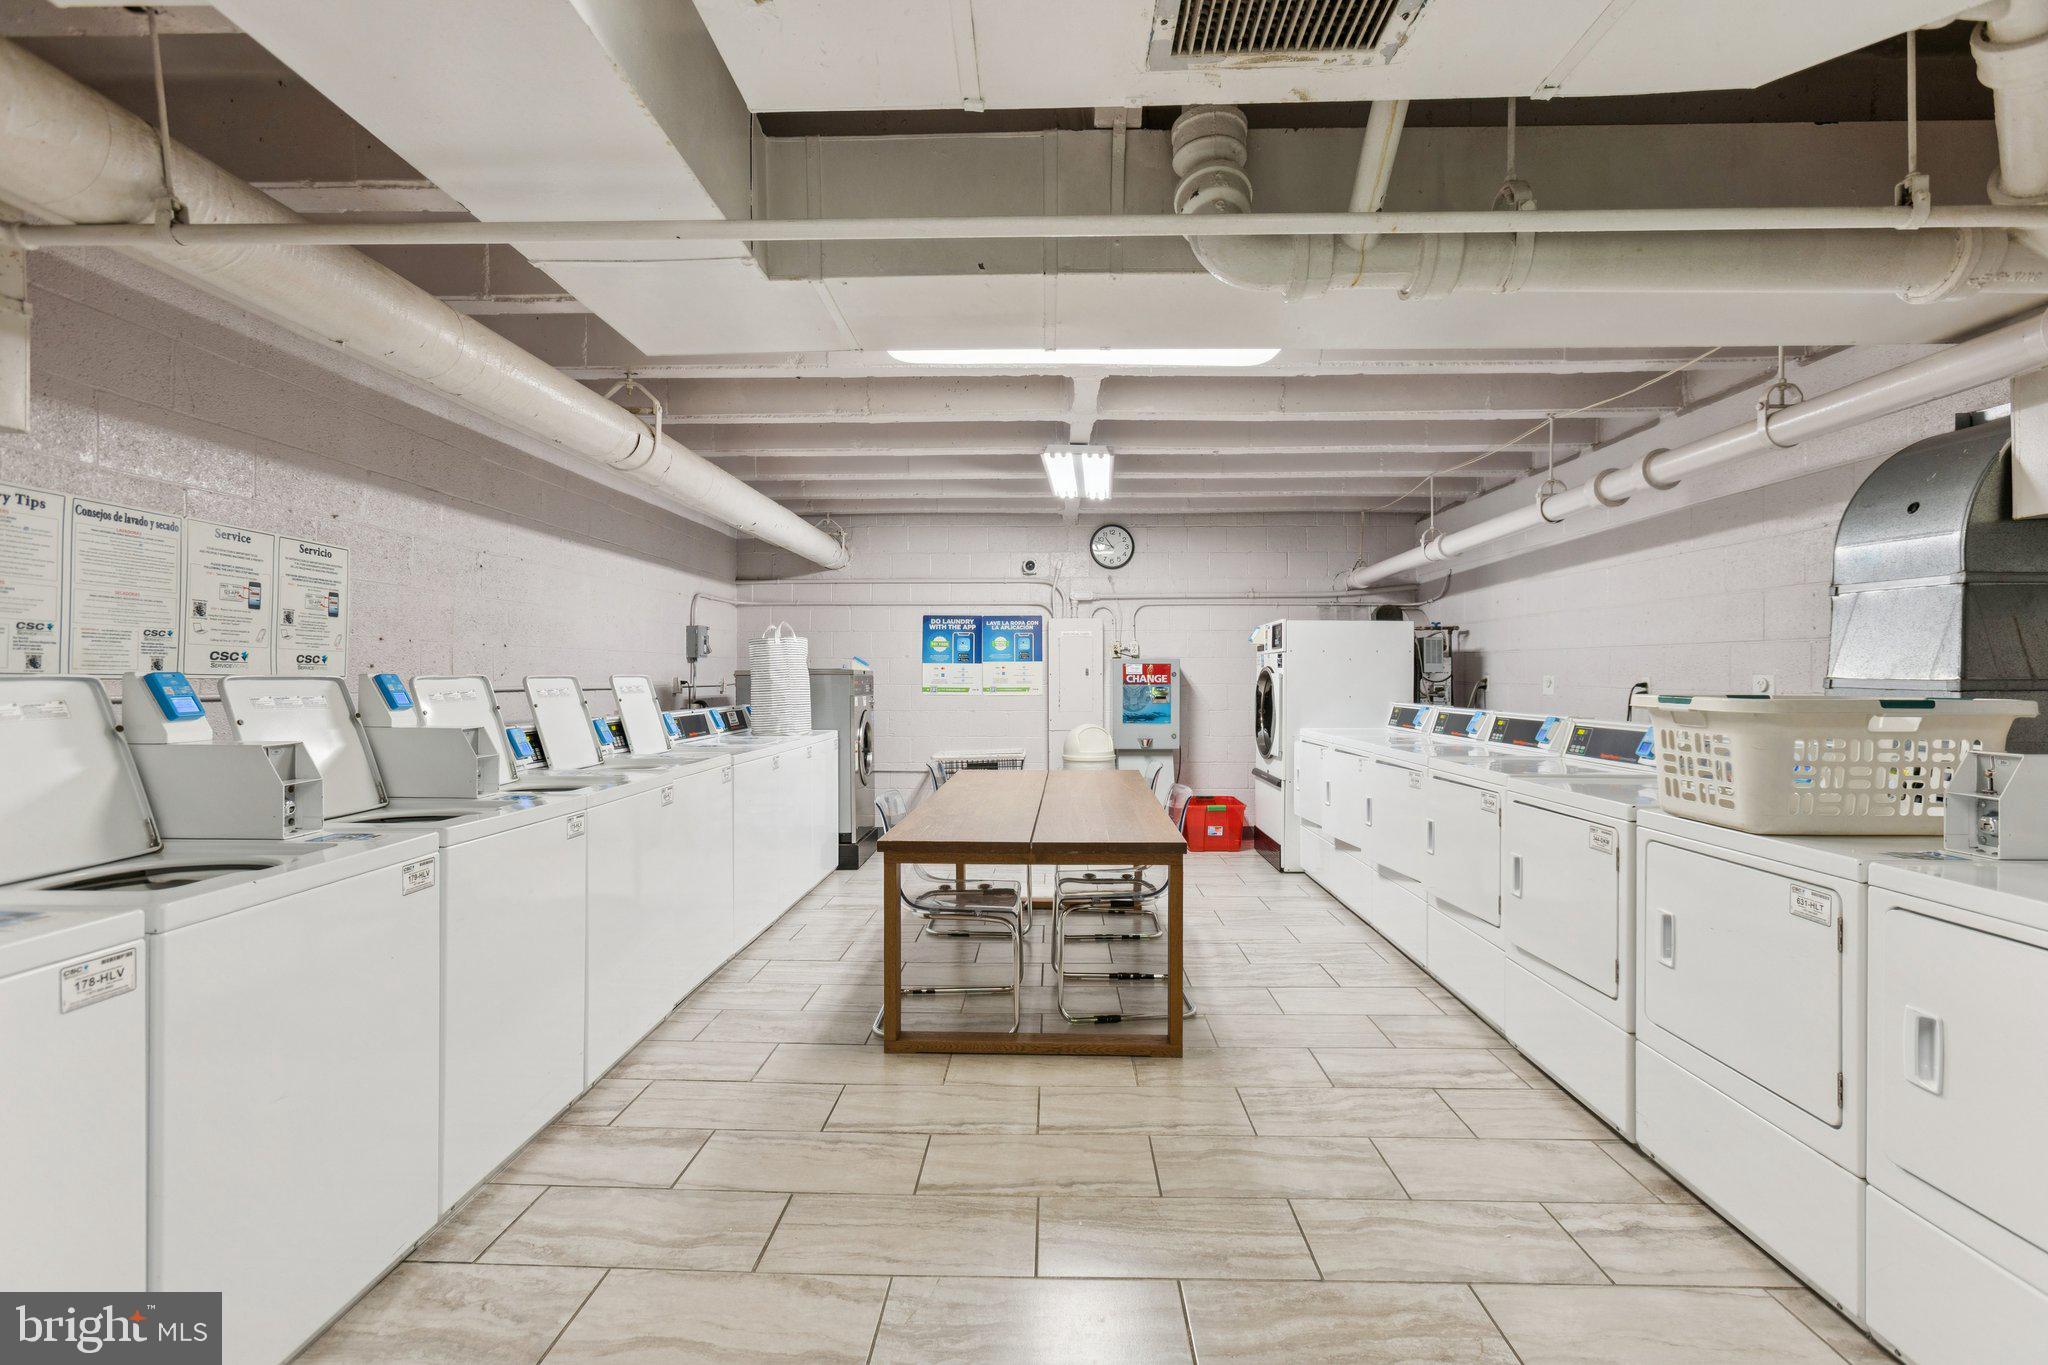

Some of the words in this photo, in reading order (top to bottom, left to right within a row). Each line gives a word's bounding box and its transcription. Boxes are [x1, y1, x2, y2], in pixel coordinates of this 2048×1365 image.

[15, 493, 46, 510] Tips
[74, 504, 112, 521] Consejos
[113, 511, 123, 522] de
[124, 513, 149, 527] lavado
[150, 520, 156, 530] y
[156, 521, 180, 533] secado
[214, 527, 252, 544] Service
[299, 543, 333, 559] Servicio
[15, 621, 45, 631] CSC
[143, 629, 167, 637] CSC
[209, 650, 240, 661] CSC
[296, 654, 321, 664] CSC
[1126, 674, 1168, 683] CHANGE
[1796, 897, 1824, 911] 631-HLT
[75, 967, 125, 991] 178-HLV
